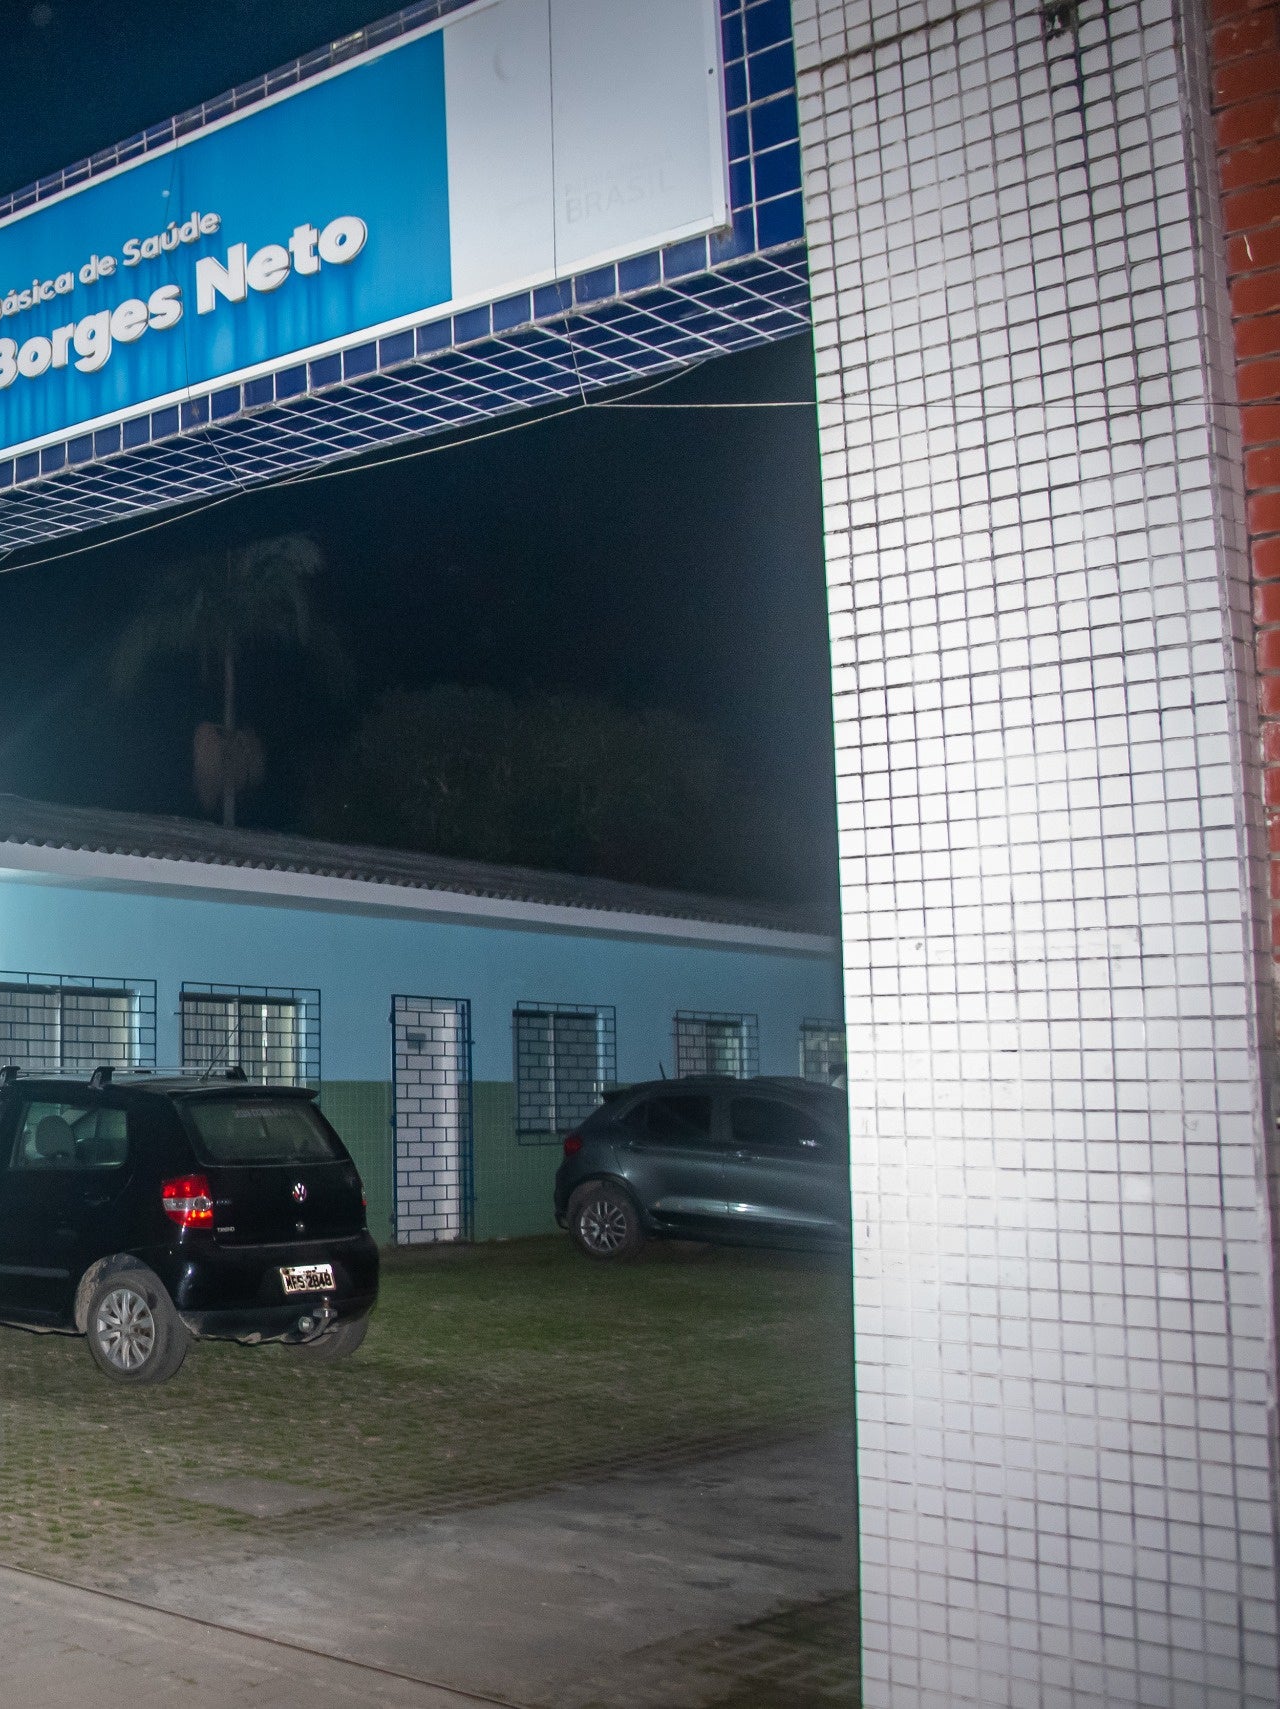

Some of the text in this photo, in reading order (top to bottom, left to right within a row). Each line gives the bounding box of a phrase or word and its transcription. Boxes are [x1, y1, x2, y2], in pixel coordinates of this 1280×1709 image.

[565, 167, 677, 225] BRASIL
[78, 253, 118, 285] de
[122, 209, 222, 268] Saúde
[195, 215, 369, 315] Neto
